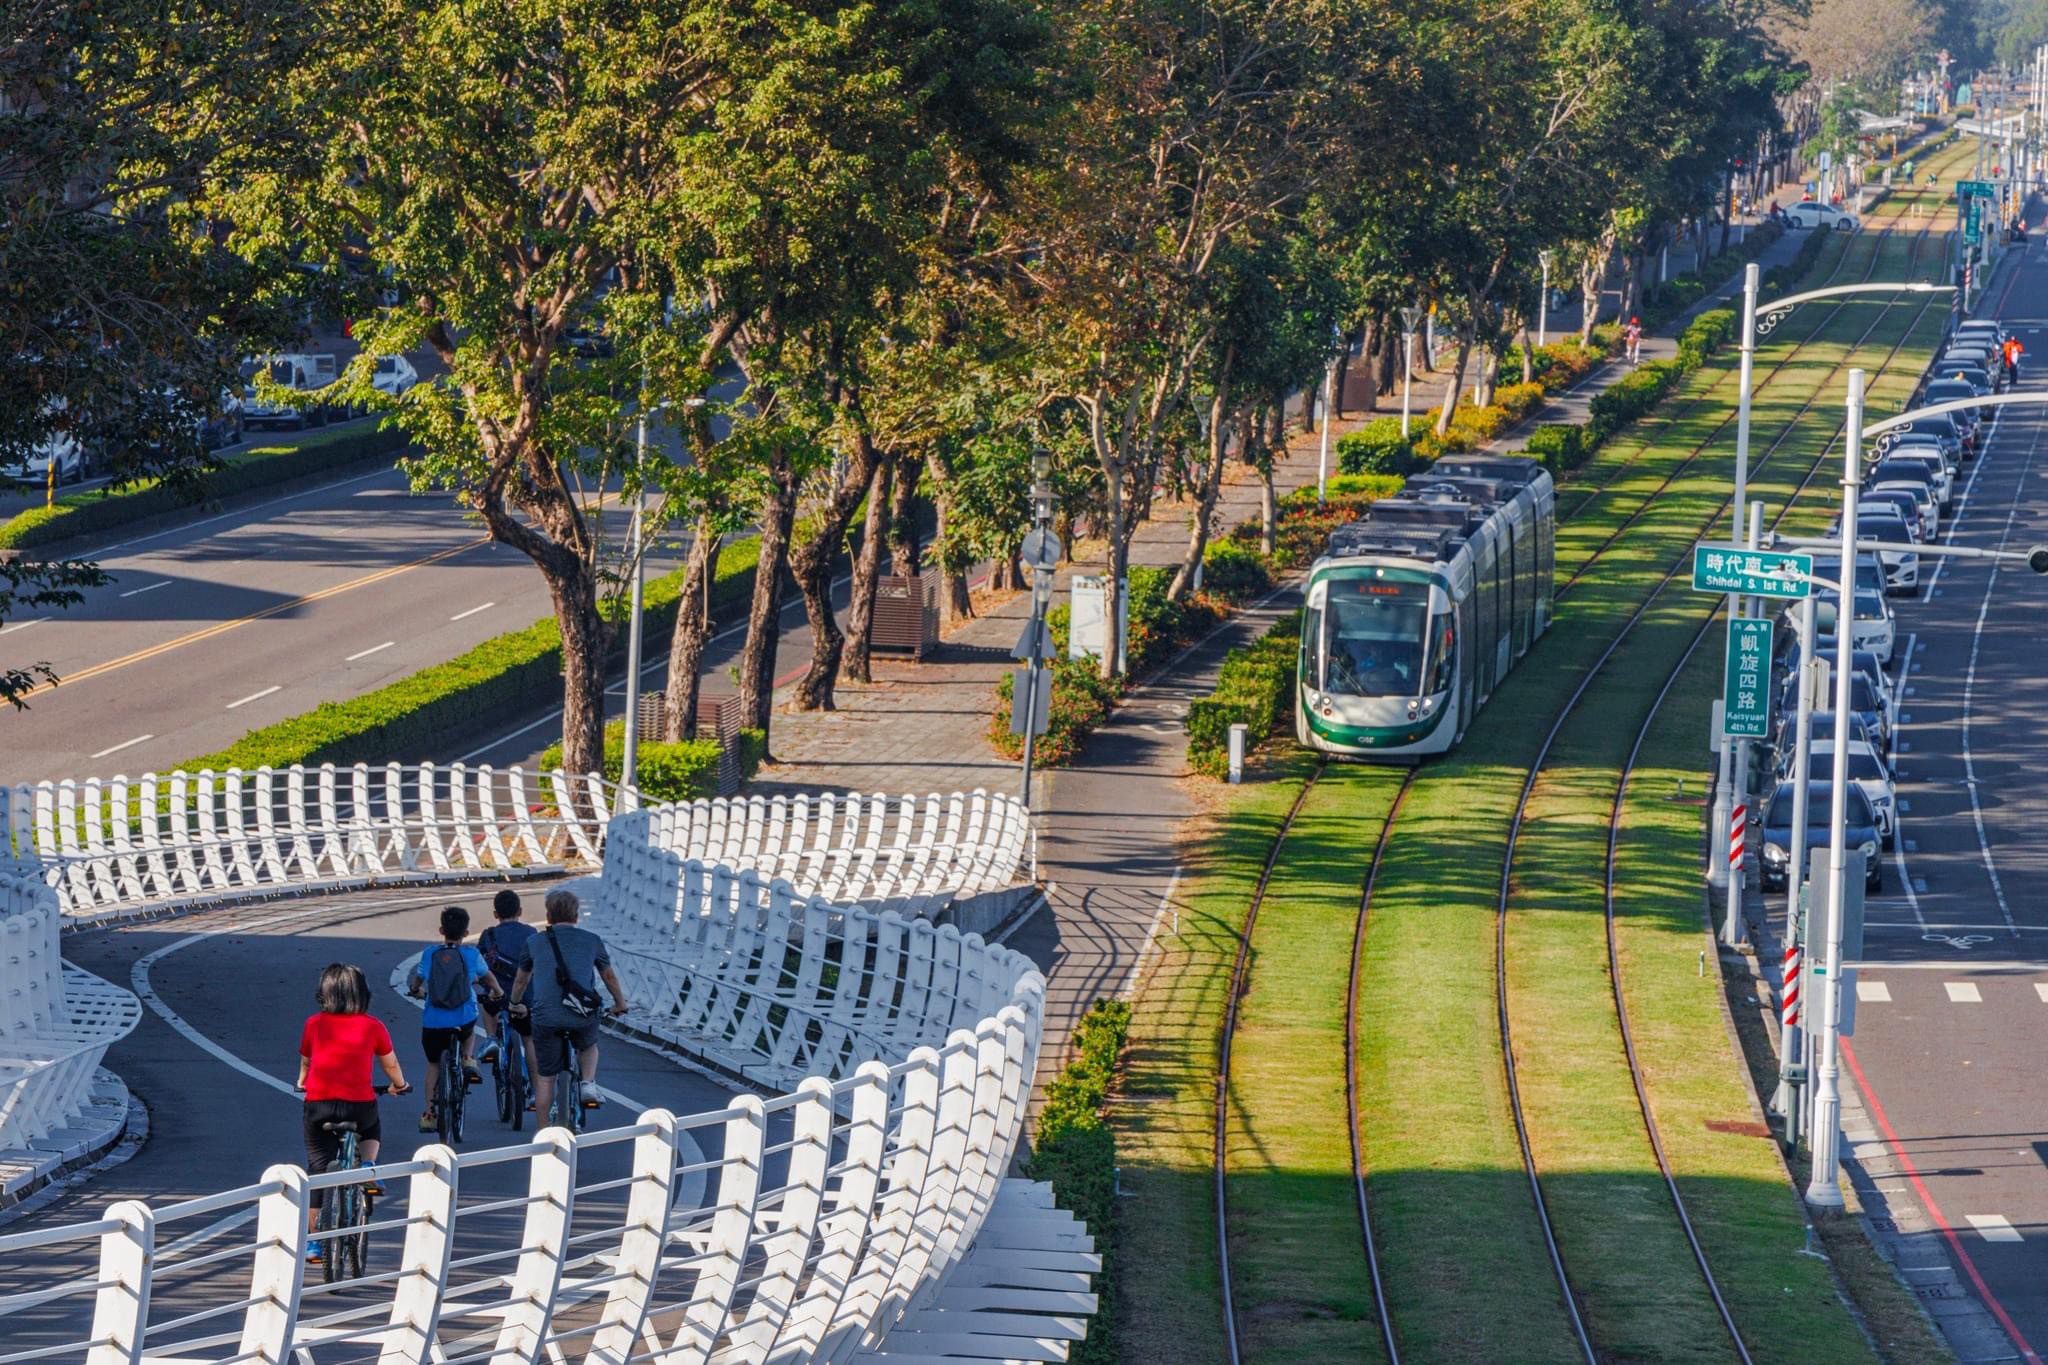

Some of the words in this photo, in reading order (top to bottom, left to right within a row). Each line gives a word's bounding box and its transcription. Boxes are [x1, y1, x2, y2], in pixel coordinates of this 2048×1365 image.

[1705, 575, 1742, 588] Shihdai
[1760, 623, 1768, 632] W
[1737, 634, 1760, 710] 凱旋四路
[1727, 711, 1765, 722] Kaisyuan
[1731, 723, 1745, 731] 4th
